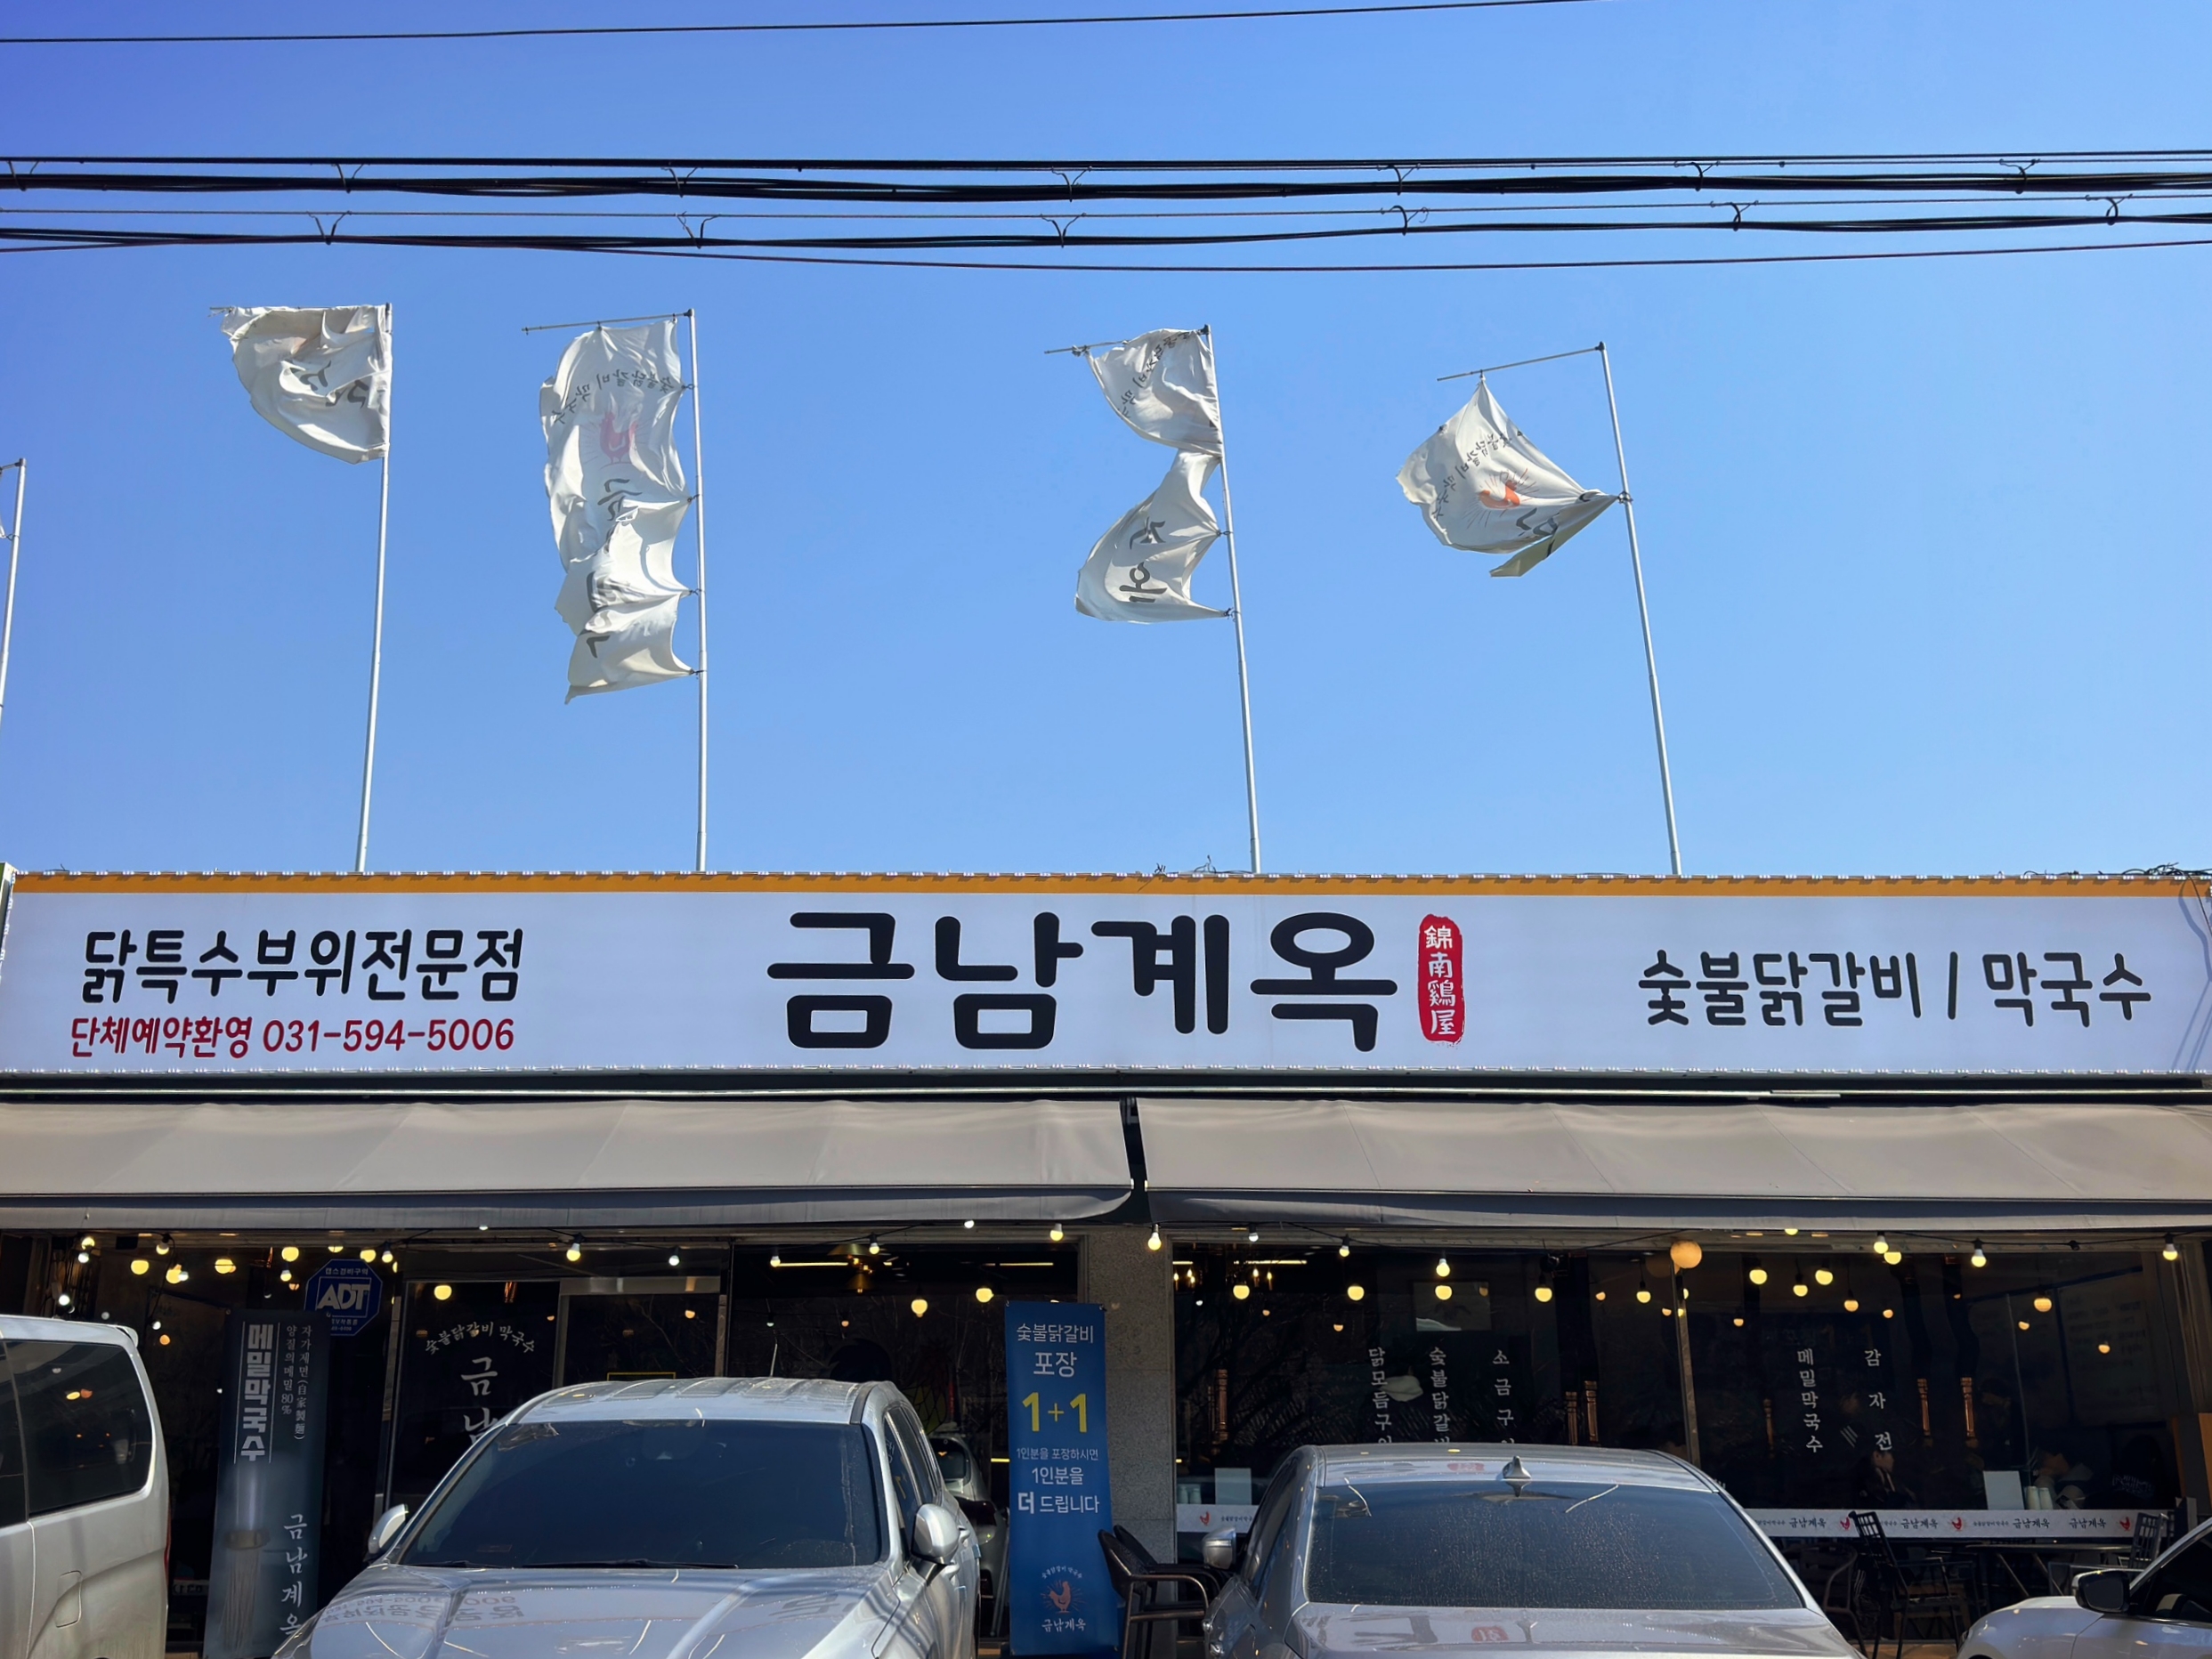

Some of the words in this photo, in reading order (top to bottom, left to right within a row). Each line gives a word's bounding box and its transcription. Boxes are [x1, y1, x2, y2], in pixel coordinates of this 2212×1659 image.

[82, 927, 525, 1005] 닭특수부위전문점
[766, 911, 1398, 1052] 금남계옥
[1638, 949, 1922, 1027] 숯불닭갈비
[1981, 951, 2151, 1028] 막국수
[70, 1016, 253, 1058] 단체예약환영
[263, 1017, 515, 1053] 031-594-5006
[317, 1283, 370, 1310] ADT
[499, 1325, 535, 1353] 막국수
[1016, 1323, 1094, 1344] 숯불닭갈비
[1033, 1351, 1078, 1378] 포장
[240, 1323, 274, 1461] 메밀막국수
[1492, 1349, 1515, 1444] 소금구
[1797, 1347, 1824, 1453] 메밀막국수
[1864, 1348, 1892, 1451] 감자전
[1016, 1447, 1049, 1460] 1인분을
[1051, 1448, 1099, 1461] 포장하시면
[1032, 1467, 1084, 1485] 1인분을
[1017, 1492, 1034, 1514] 더
[1039, 1494, 1100, 1514] 드립니다
[1789, 1517, 1827, 1528] 금남계옥
[1900, 1517, 1939, 1529] 금남계옥
[2013, 1517, 2050, 1529] 금남계옥
[1041, 1617, 1086, 1632] 금남계옥
